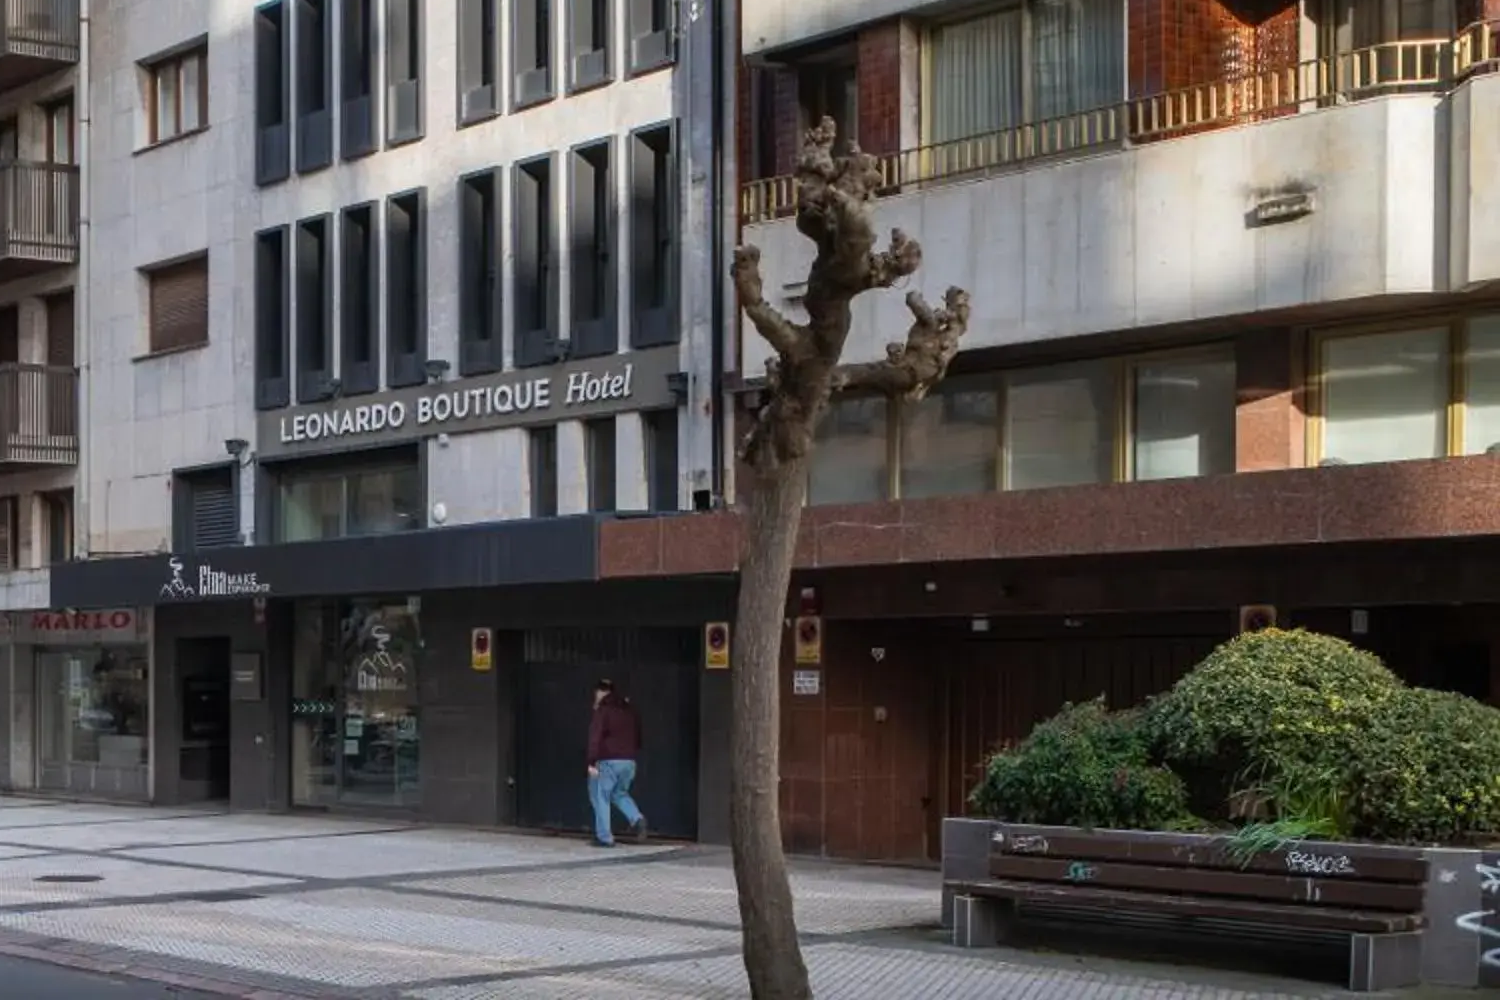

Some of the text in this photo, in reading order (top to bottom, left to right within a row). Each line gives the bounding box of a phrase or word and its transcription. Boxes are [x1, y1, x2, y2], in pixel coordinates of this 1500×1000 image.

[280, 363, 633, 442] LEONARDO BOUTIQUE Hotel
[31, 609, 131, 630] MARLO
